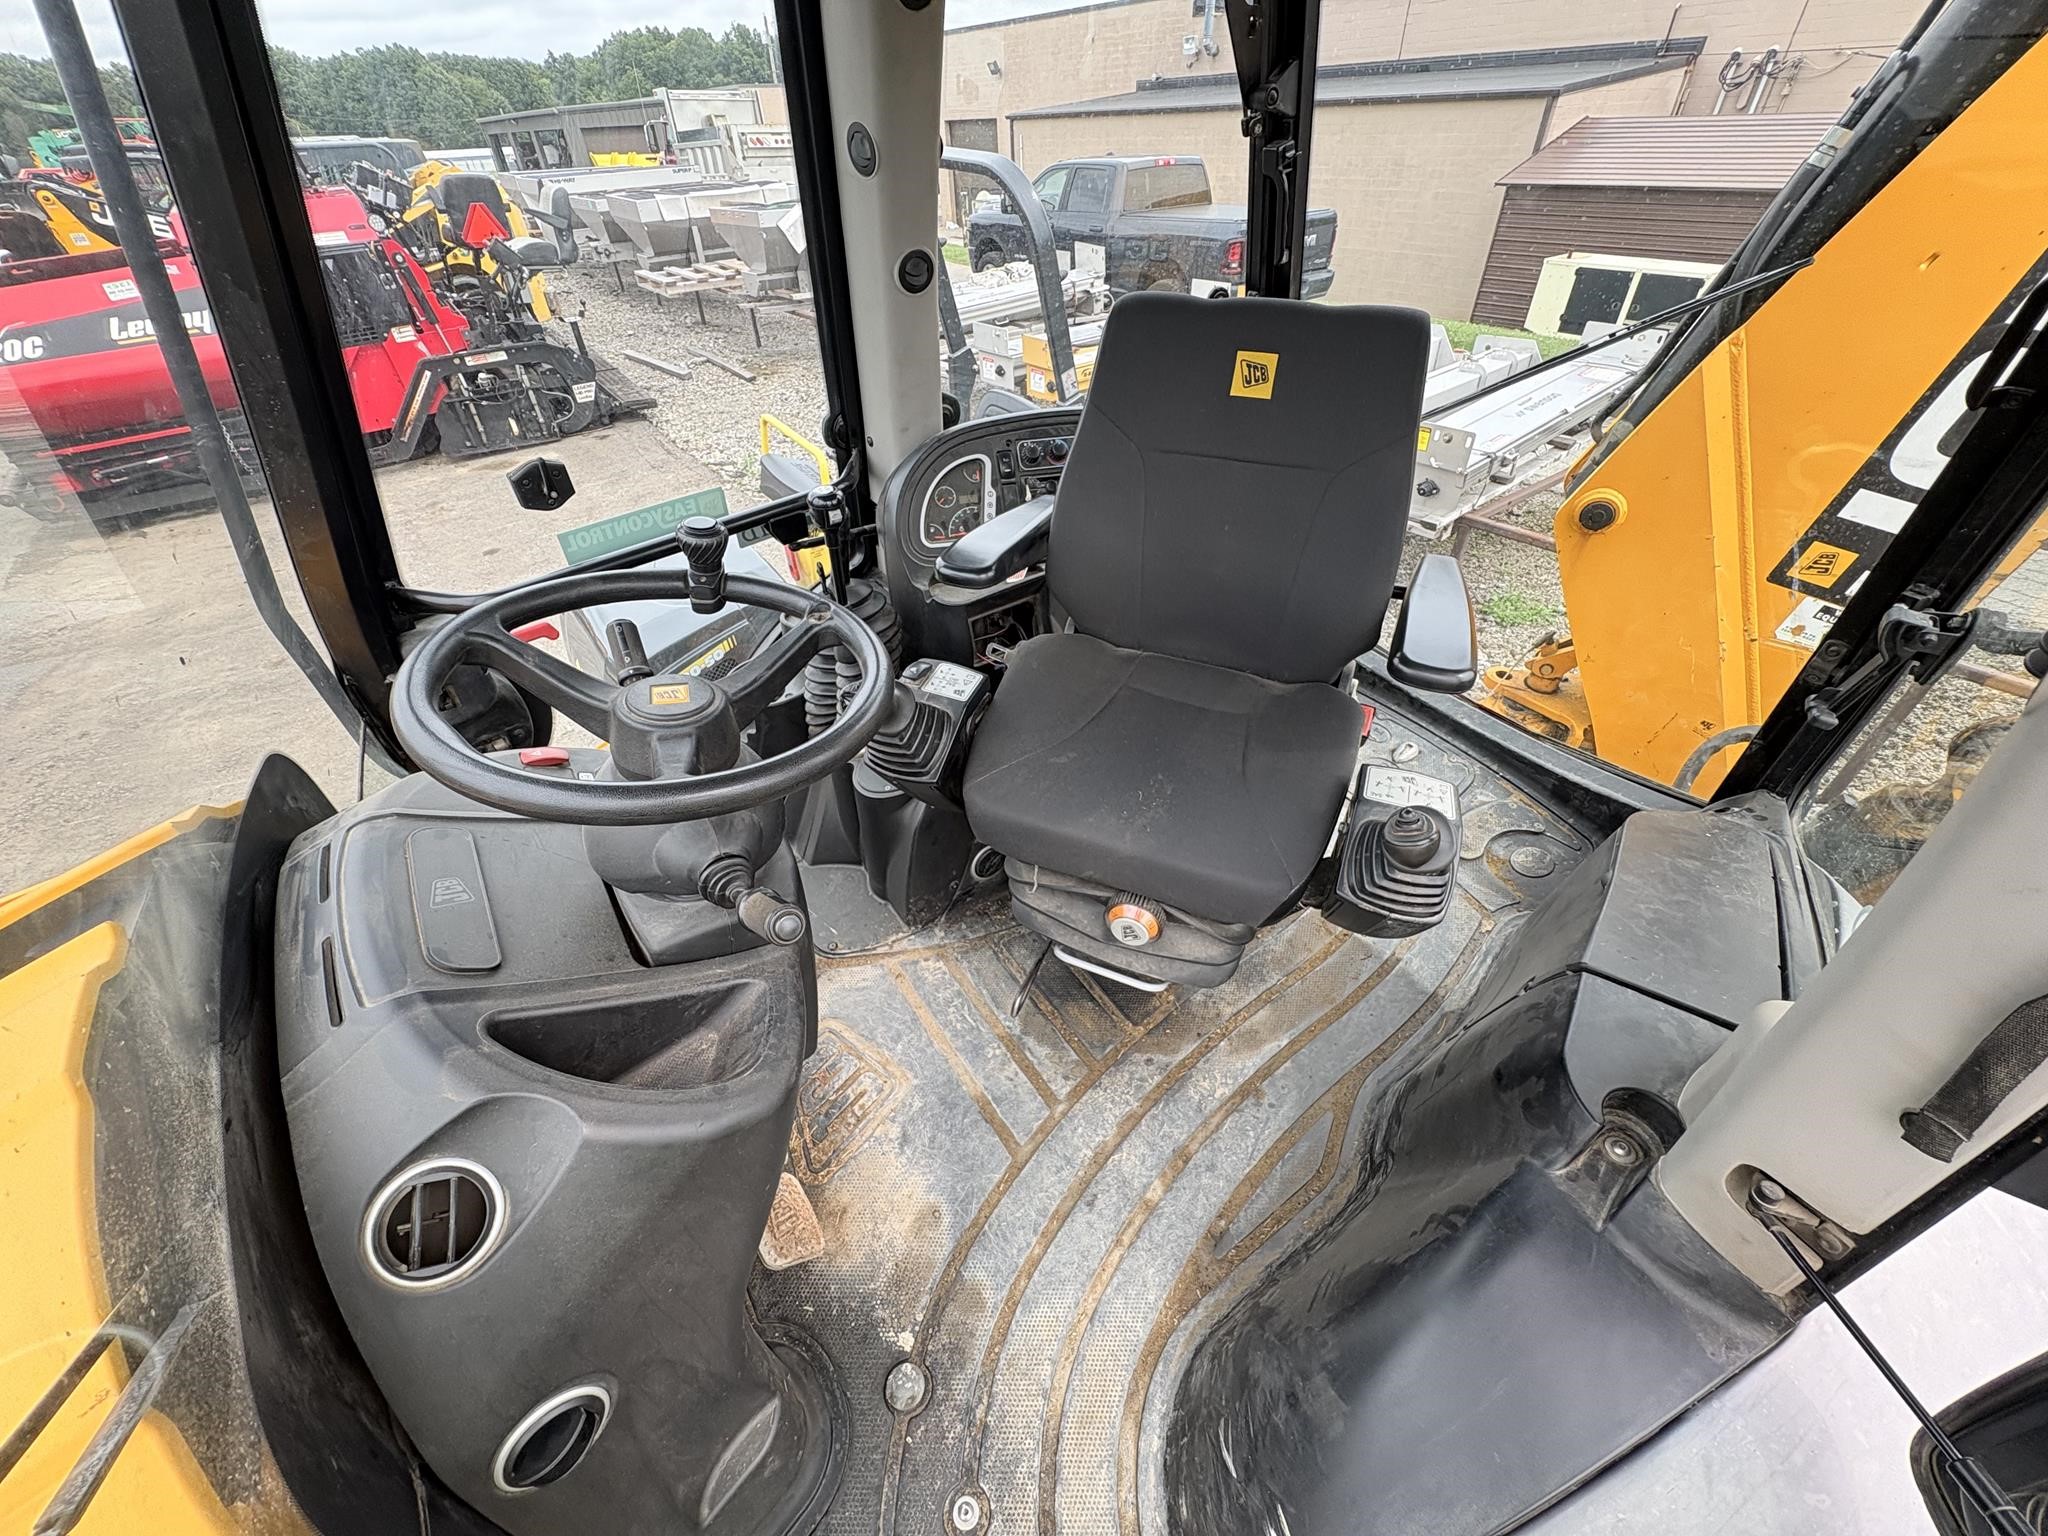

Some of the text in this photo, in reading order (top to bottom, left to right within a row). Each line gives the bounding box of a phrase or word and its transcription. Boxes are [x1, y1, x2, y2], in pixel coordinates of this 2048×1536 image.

[109, 309, 211, 341] Ley
[0, 336, 44, 362] 0C
[1244, 362, 1268, 386] JCB
[1805, 552, 1837, 574] JCB
[433, 879, 472, 904] JCB
